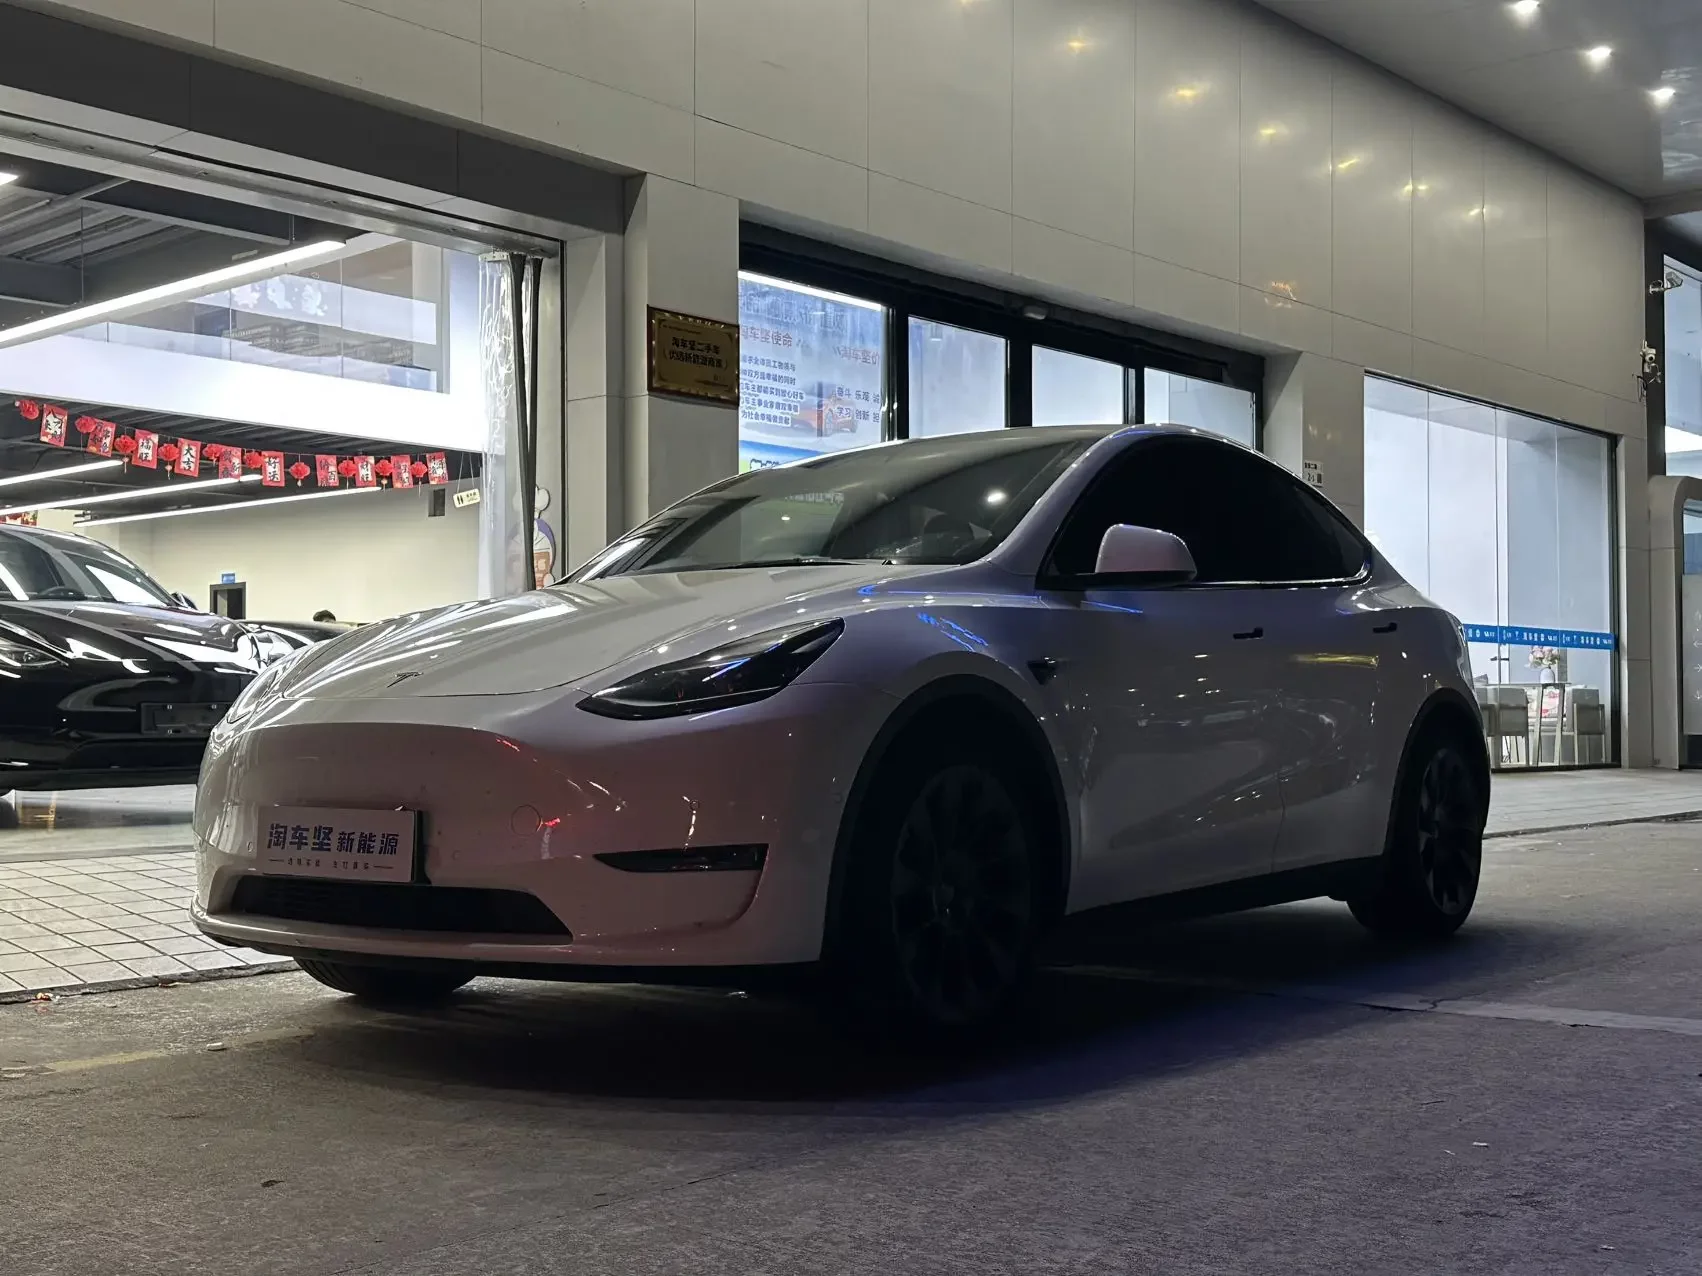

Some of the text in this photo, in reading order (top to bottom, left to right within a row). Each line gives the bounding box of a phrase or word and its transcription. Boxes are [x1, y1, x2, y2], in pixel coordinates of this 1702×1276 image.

[182, 444, 195, 472] 大吉
[266, 823, 400, 855] 淘车坚新能源
